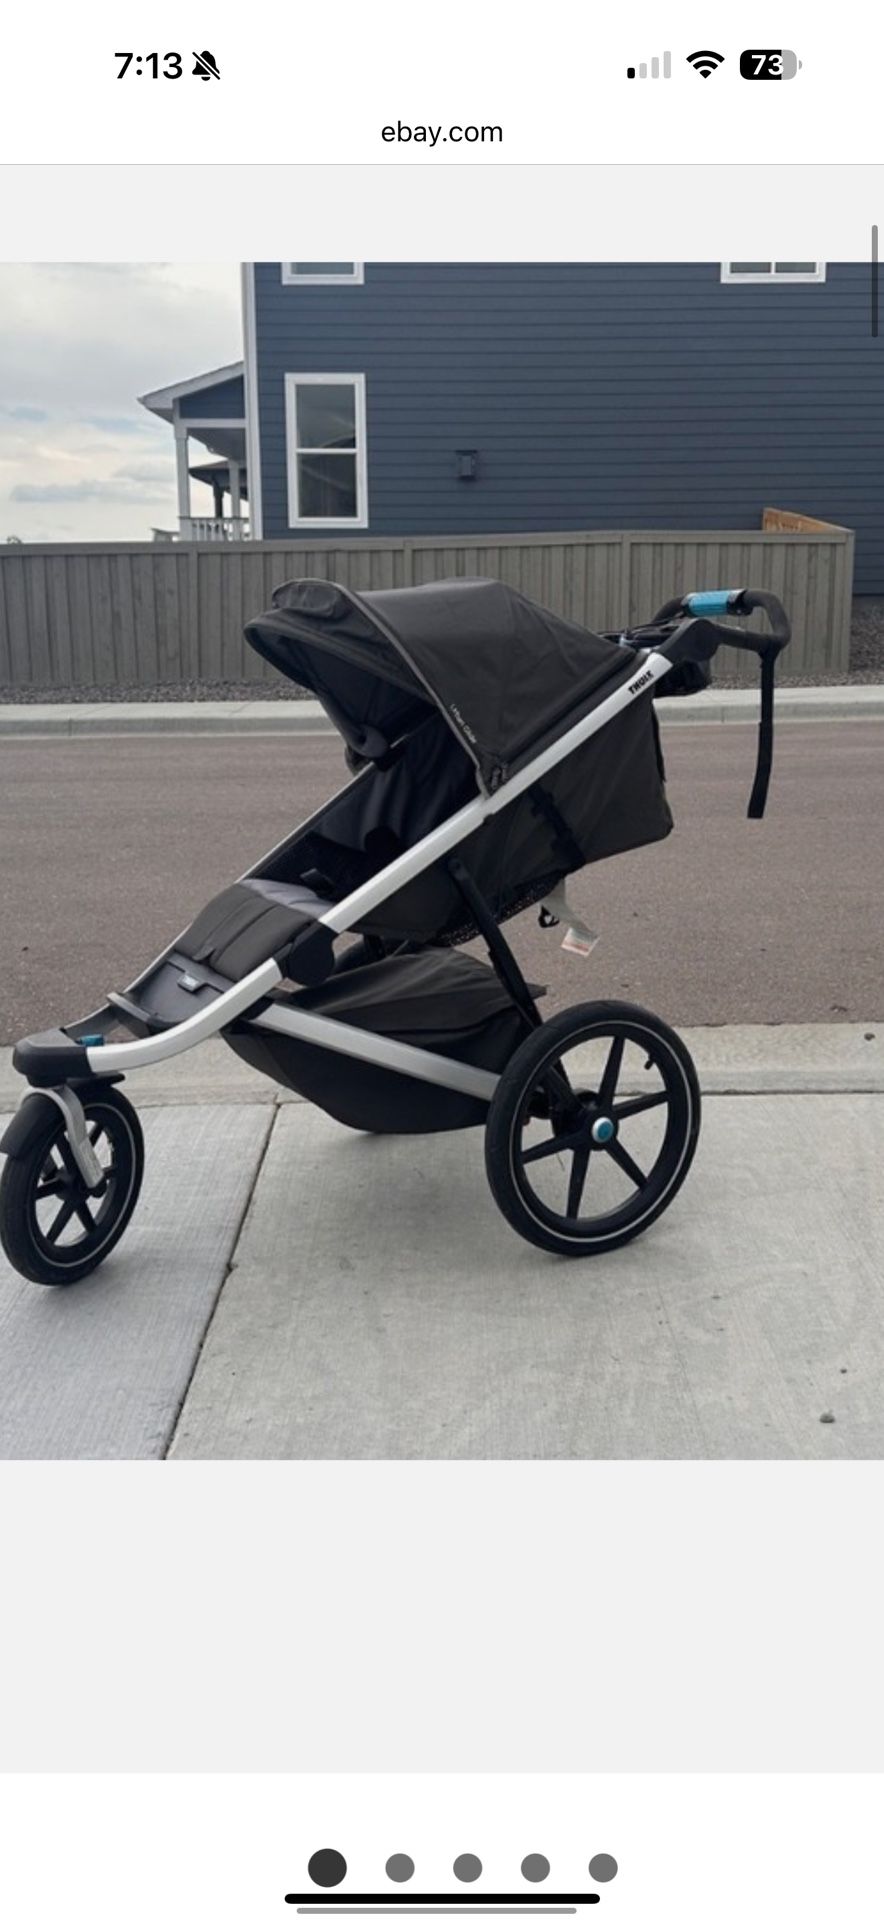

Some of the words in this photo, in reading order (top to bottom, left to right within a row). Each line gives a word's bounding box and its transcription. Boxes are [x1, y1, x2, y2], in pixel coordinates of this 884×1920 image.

[113, 51, 183, 80] 7:13
[751, 54, 784, 76] 73
[381, 119, 503, 148] ebay.com
